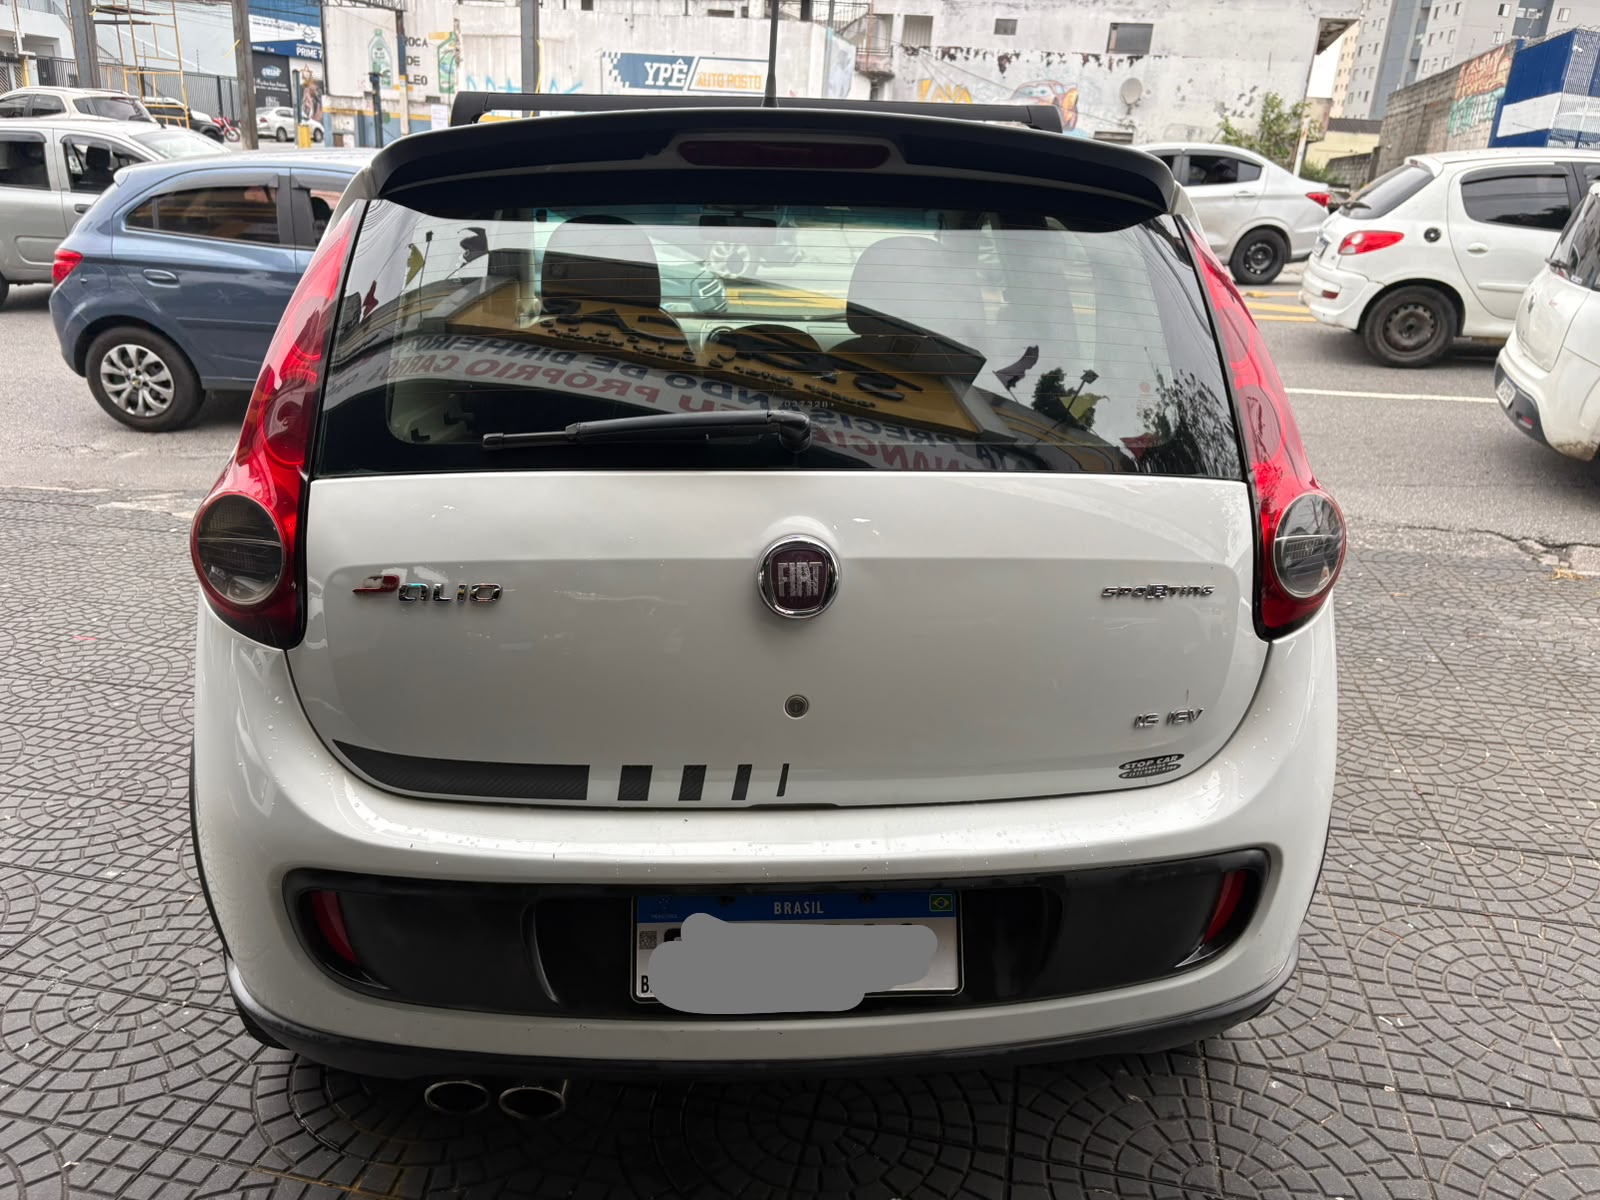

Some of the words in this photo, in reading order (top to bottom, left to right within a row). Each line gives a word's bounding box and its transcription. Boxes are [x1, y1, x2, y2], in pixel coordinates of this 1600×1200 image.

[296, 47, 318, 58] PRIME
[406, 56, 421, 67] DE
[644, 58, 689, 87] YPÊ
[696, 71, 727, 89] AUTO
[728, 73, 764, 91] POSTO
[777, 561, 823, 597] FIAT
[1101, 584, 1215, 600] SPORTING
[1124, 759, 1154, 770] STOP
[1156, 755, 1179, 764] CAR
[773, 901, 825, 914] BRASIL
